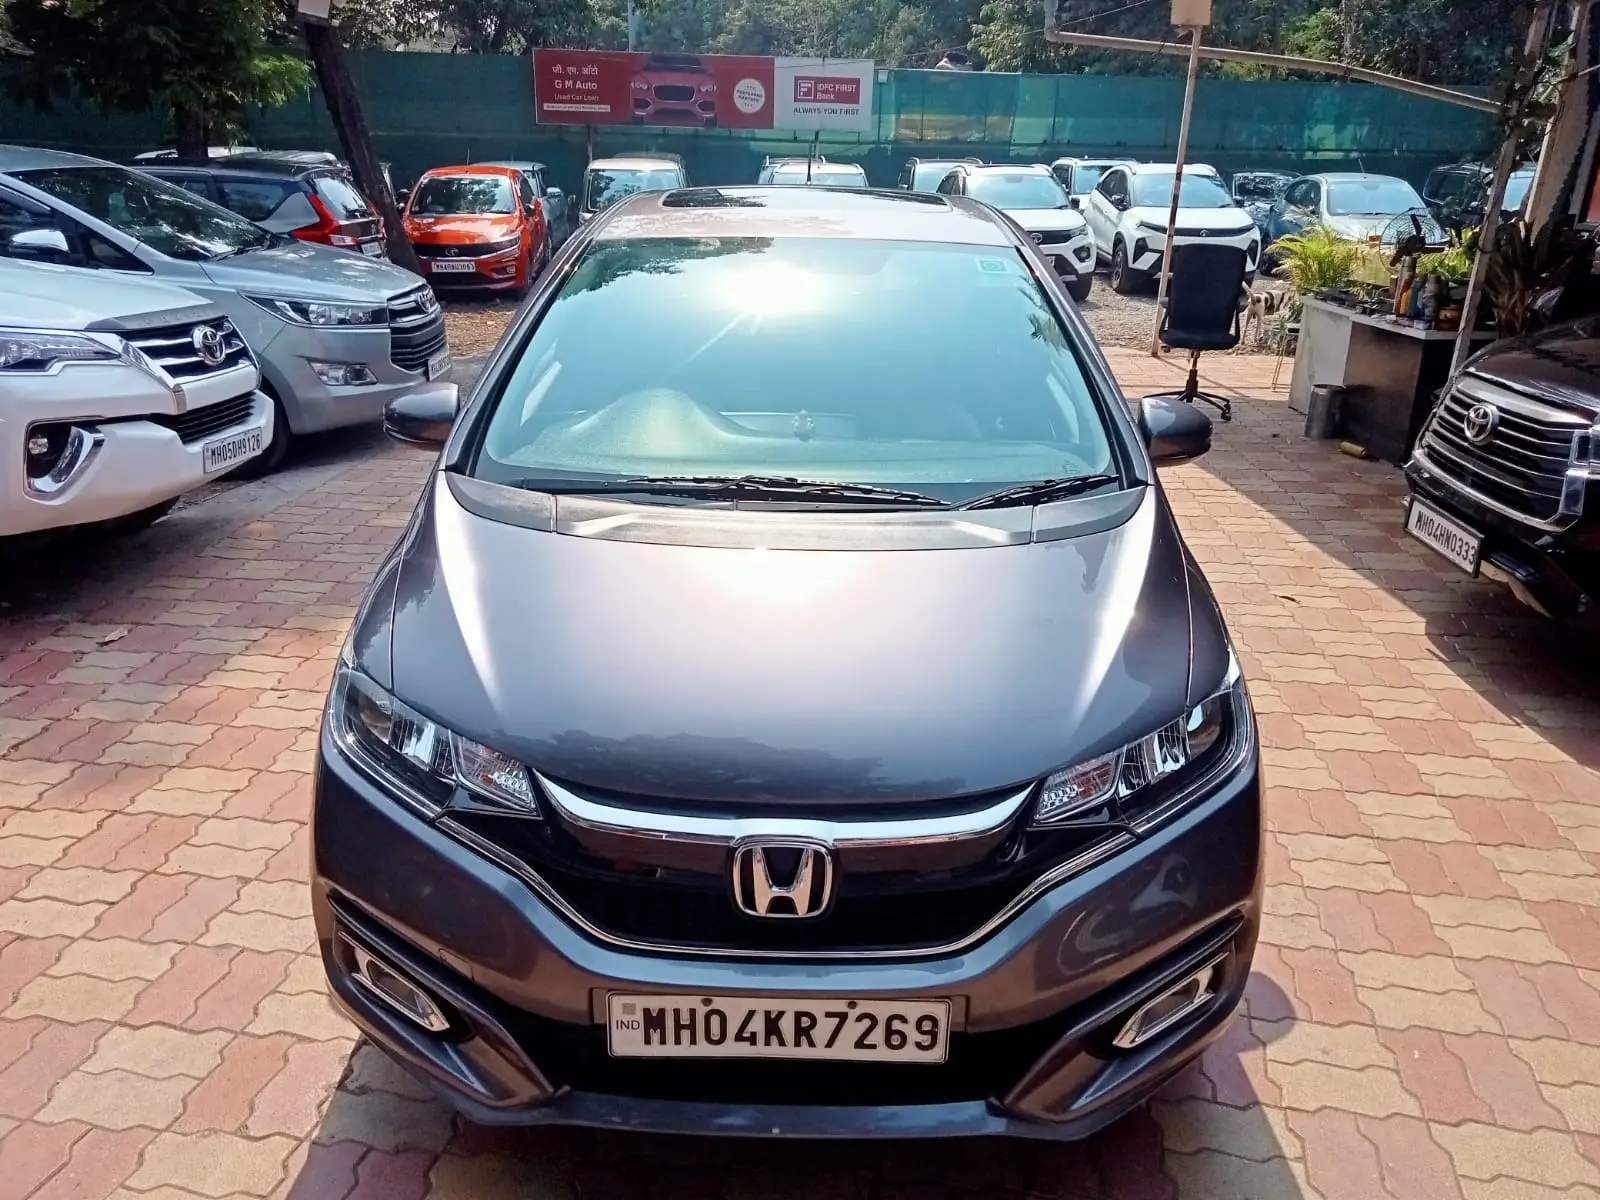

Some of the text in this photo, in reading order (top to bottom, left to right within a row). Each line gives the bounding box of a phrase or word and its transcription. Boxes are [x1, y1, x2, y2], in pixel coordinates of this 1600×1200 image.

[554, 80, 598, 90] G M Auto
[816, 83, 857, 92] IDFC FIRST
[816, 92, 835, 100] Bank
[793, 107, 860, 116] ALWAYS YOU FIRST
[211, 433, 261, 467] MH05DH9126
[1414, 510, 1477, 566] MH04HN0333
[616, 1007, 939, 1052] IND MH04KR7269
